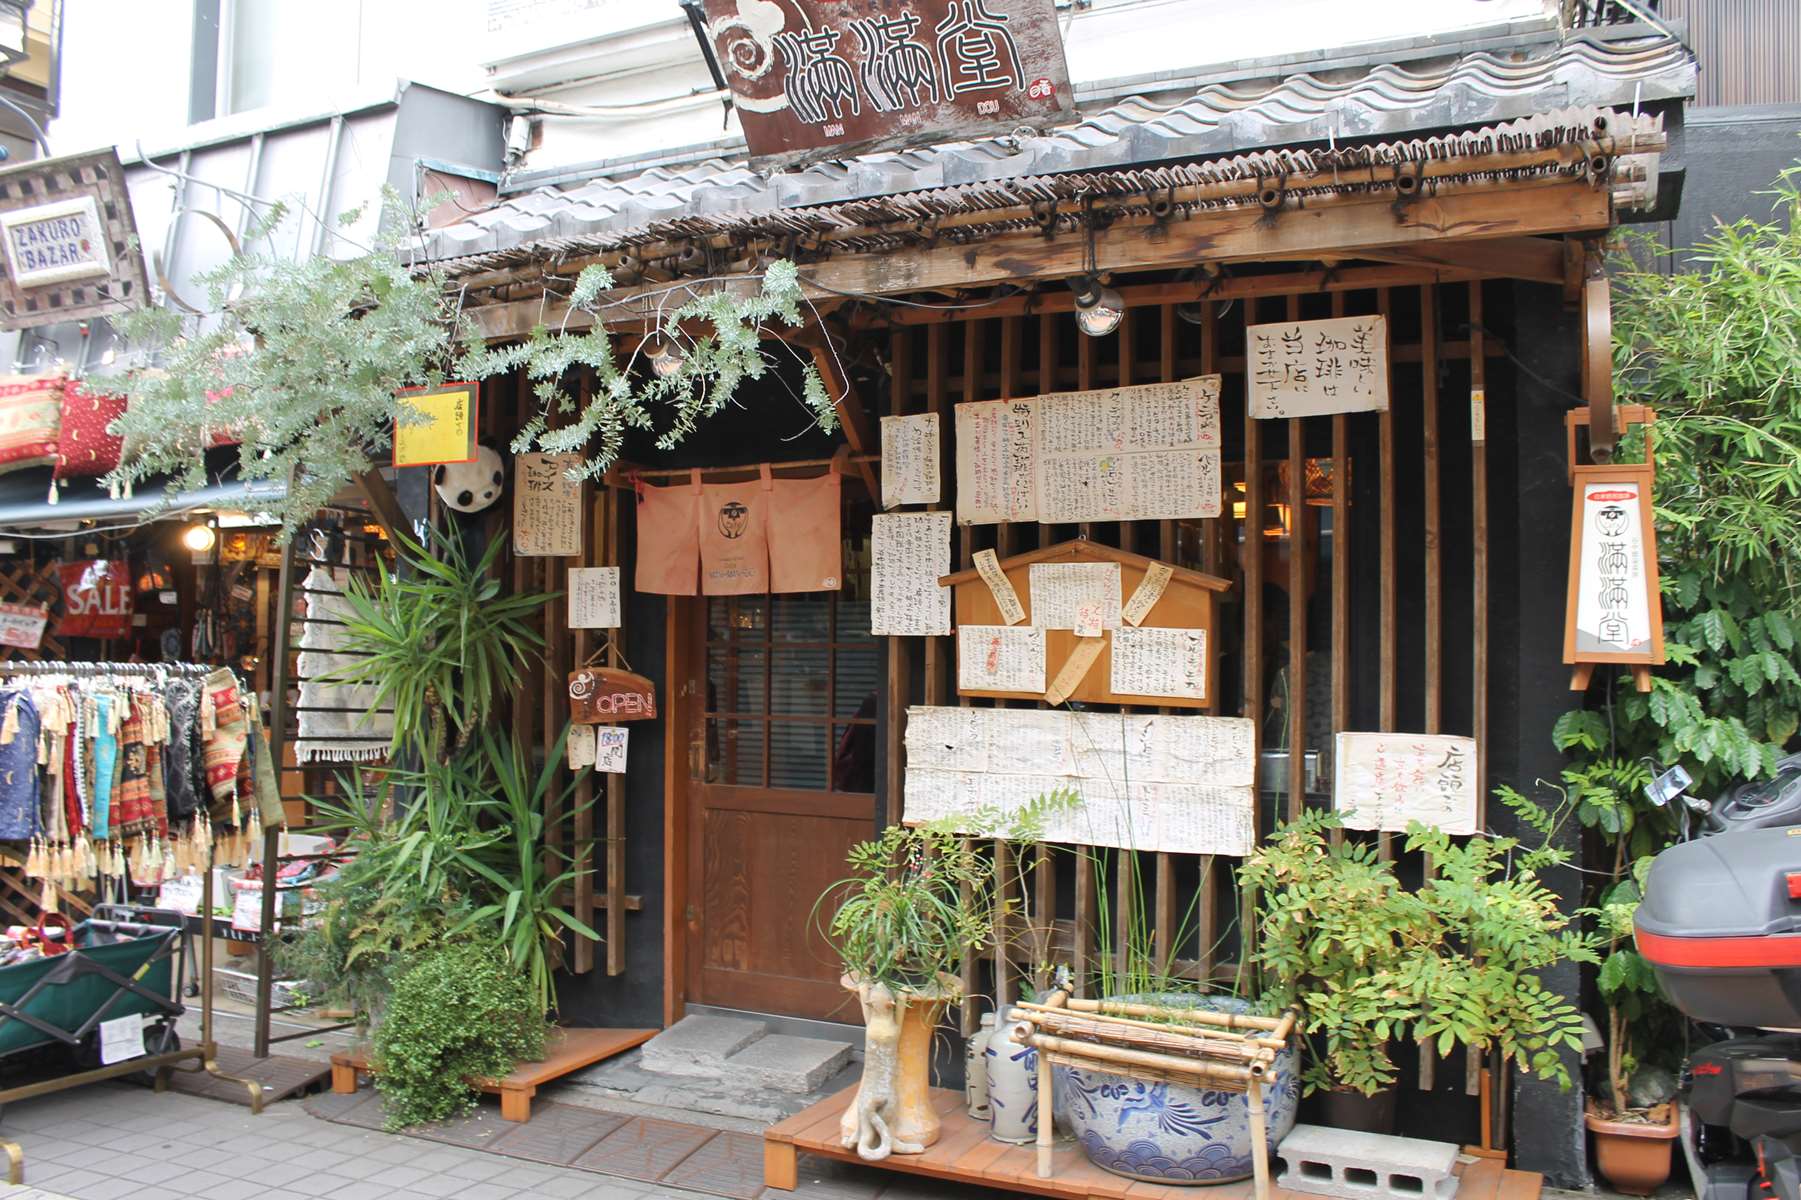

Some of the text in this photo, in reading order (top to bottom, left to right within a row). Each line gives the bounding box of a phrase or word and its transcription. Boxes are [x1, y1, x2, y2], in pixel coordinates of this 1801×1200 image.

[16, 218, 81, 247] ZAKURO
[24, 242, 81, 269] BAZAR
[66, 583, 133, 616] SALE
[596, 692, 653, 714] OPEN
